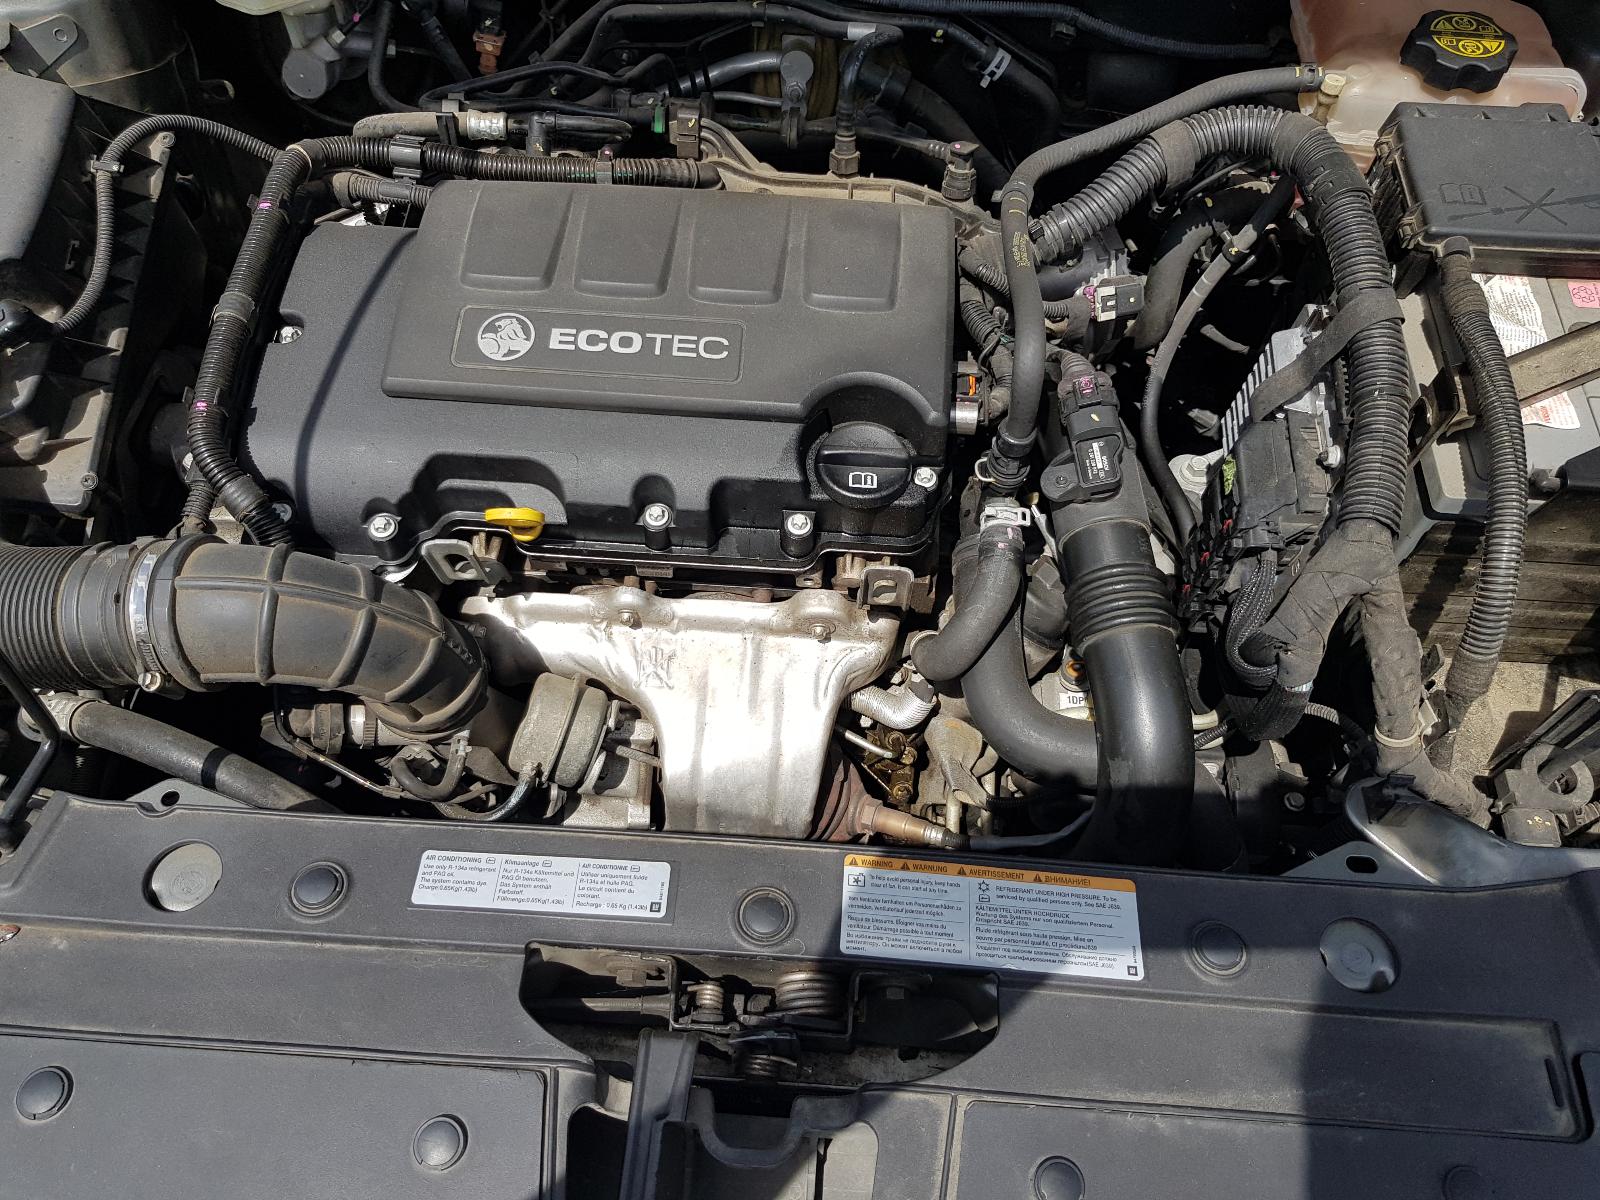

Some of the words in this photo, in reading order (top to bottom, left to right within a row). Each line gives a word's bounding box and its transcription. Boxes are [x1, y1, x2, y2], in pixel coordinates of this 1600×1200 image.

[548, 328, 729, 360] ECOTEC
[438, 855, 482, 863] CONDITIONING
[861, 859, 893, 868] WARNING
[913, 864, 948, 873] WARNUNG
[969, 868, 1025, 880] AVERTISSEMENT
[1044, 876, 1091, 886] ВНИМАНИЕ!
[996, 886, 1034, 895] REFRIGERANT
[1014, 908, 1032, 916] UNTER
[1033, 911, 1070, 919] HOCHDRUCK
